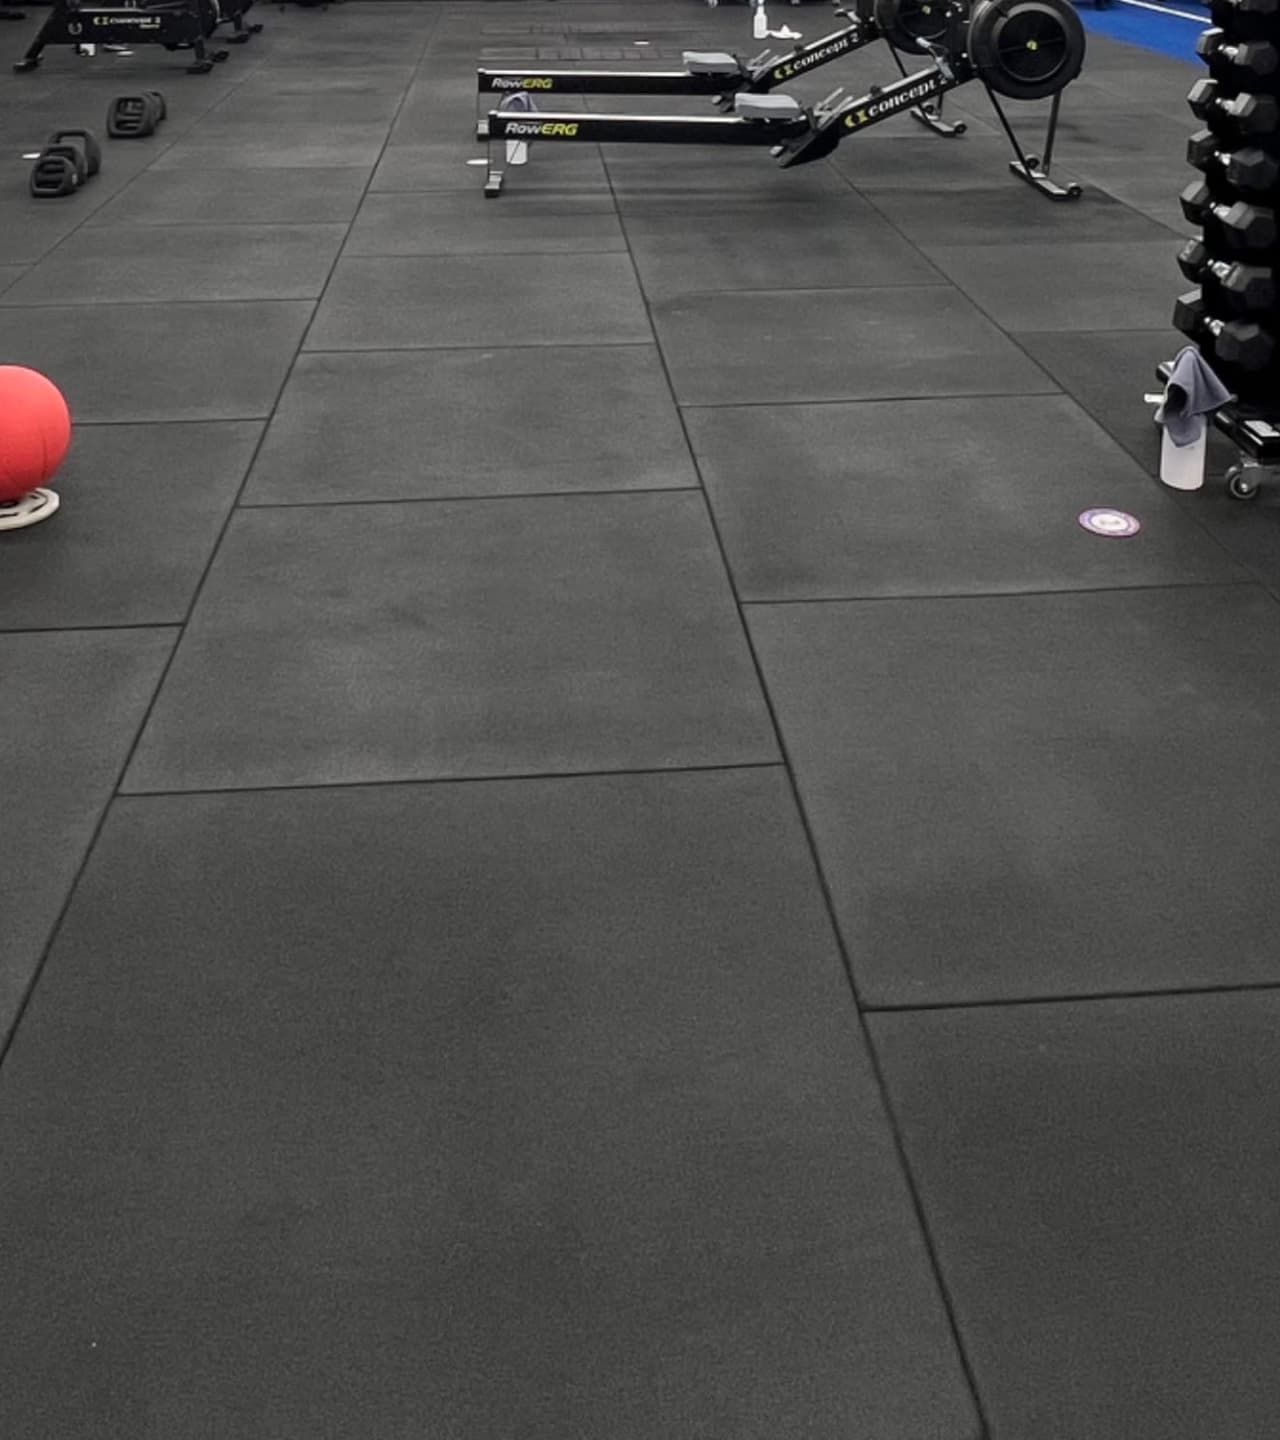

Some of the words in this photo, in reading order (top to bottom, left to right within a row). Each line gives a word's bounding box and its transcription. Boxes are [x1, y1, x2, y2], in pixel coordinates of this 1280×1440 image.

[792, 38, 849, 71] concept
[868, 78, 936, 117] concept
[505, 122, 579, 136] RowERG
